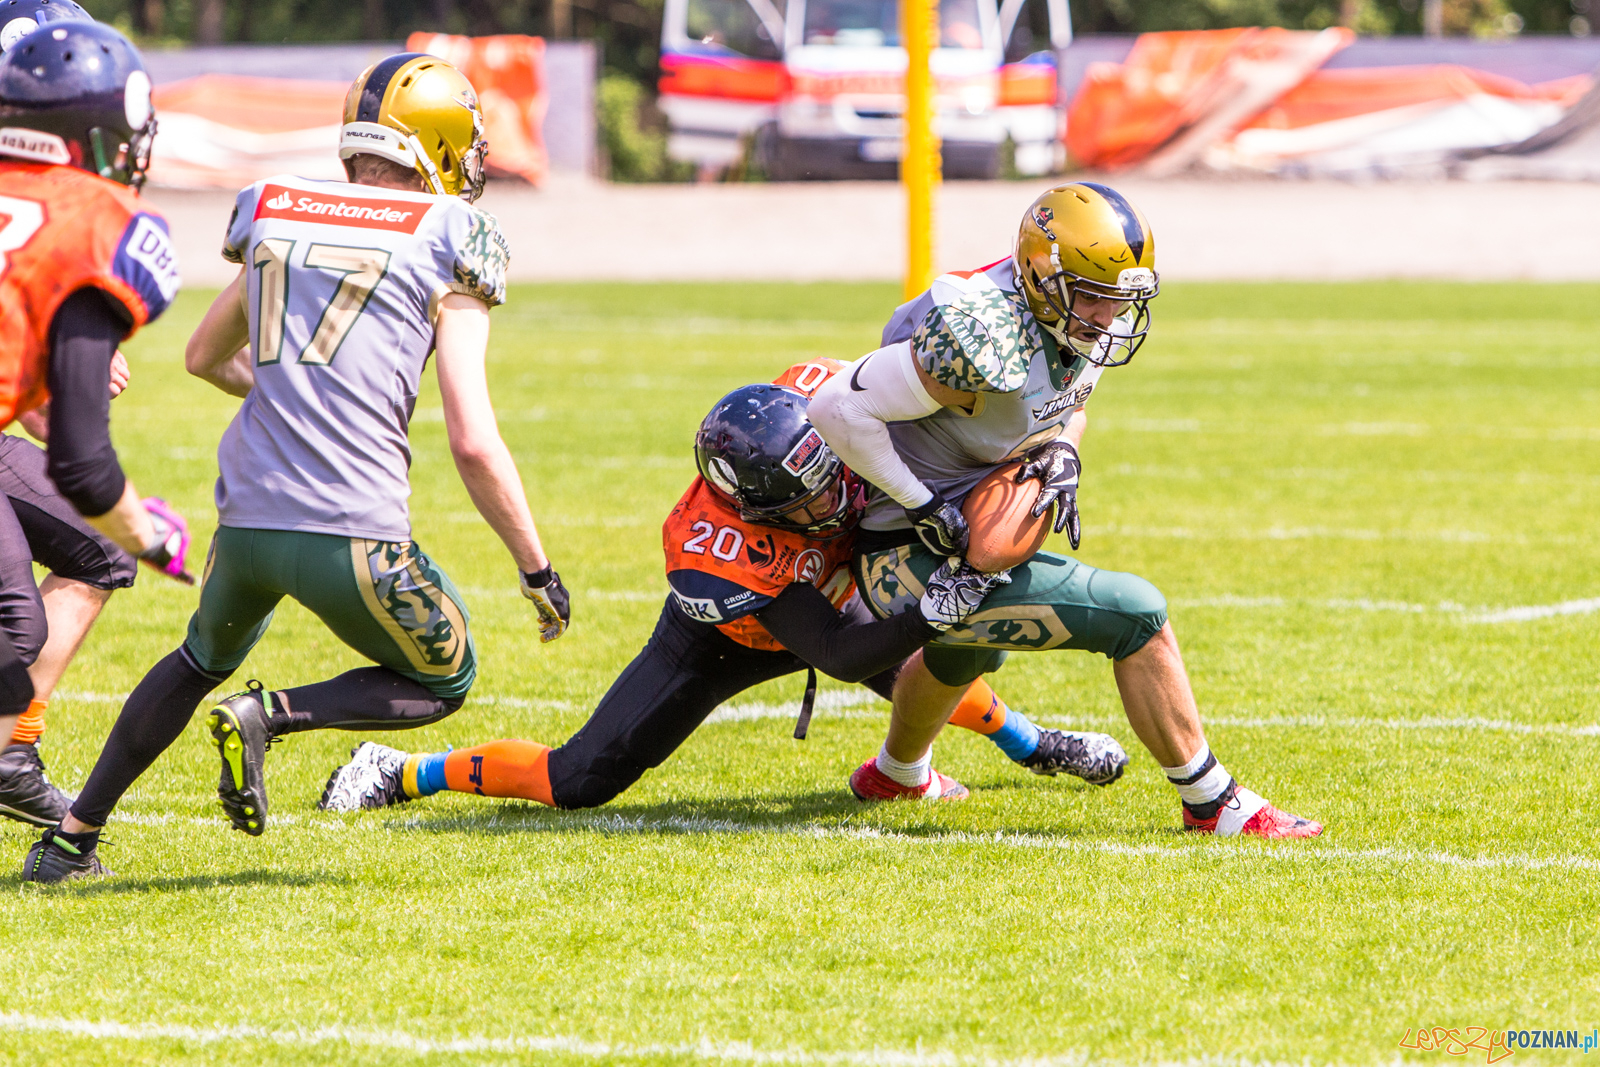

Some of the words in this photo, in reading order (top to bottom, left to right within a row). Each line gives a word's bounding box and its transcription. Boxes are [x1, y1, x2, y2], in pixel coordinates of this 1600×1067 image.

[345, 131, 386, 141] RAWLINGS
[293, 197, 413, 223] Santander
[253, 238, 392, 367] 17
[682, 519, 745, 563] 20
[723, 591, 752, 606] GROUP
